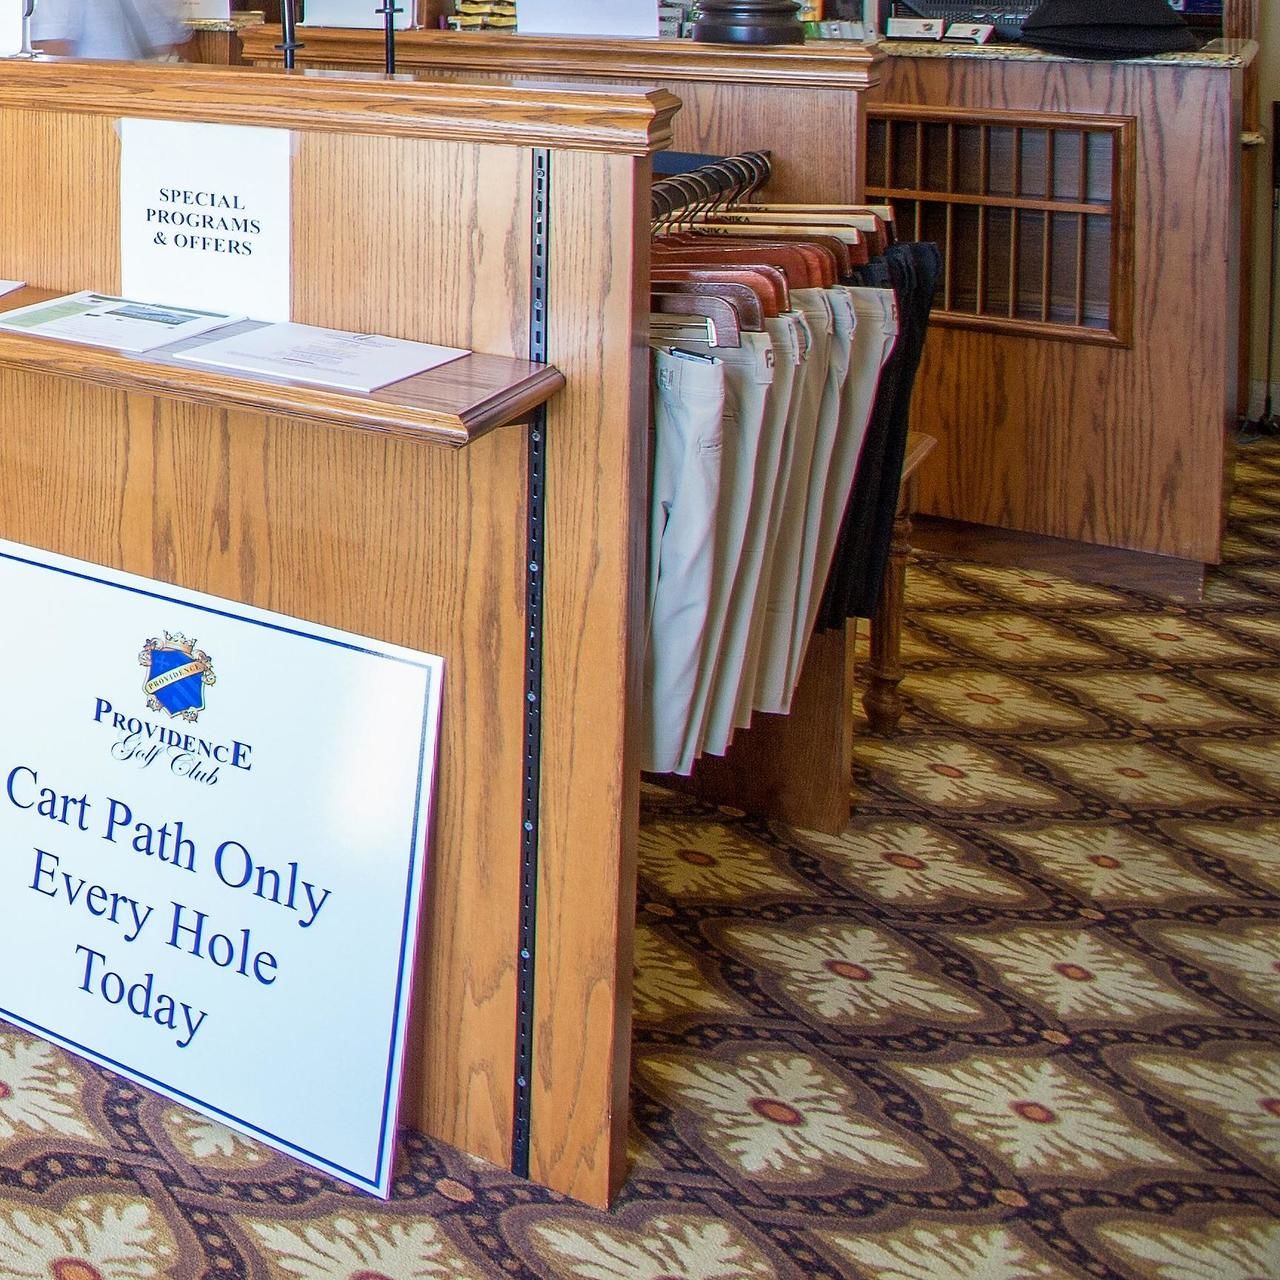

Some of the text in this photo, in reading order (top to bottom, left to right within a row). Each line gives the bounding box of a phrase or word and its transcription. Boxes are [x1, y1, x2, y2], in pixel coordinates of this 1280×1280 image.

[146, 208, 261, 234] PROGRAMS
[159, 187, 245, 210] SPECIAL
[153, 231, 252, 256] & OFFERS
[148, 664, 201, 690] PROVIDENCE
[93, 697, 252, 771] PROVIDENCE
[111, 731, 219, 785] Golf Club
[7, 766, 332, 928] Cart Path Only
[28, 847, 278, 985] Every Hole
[75, 944, 208, 1048] Today
